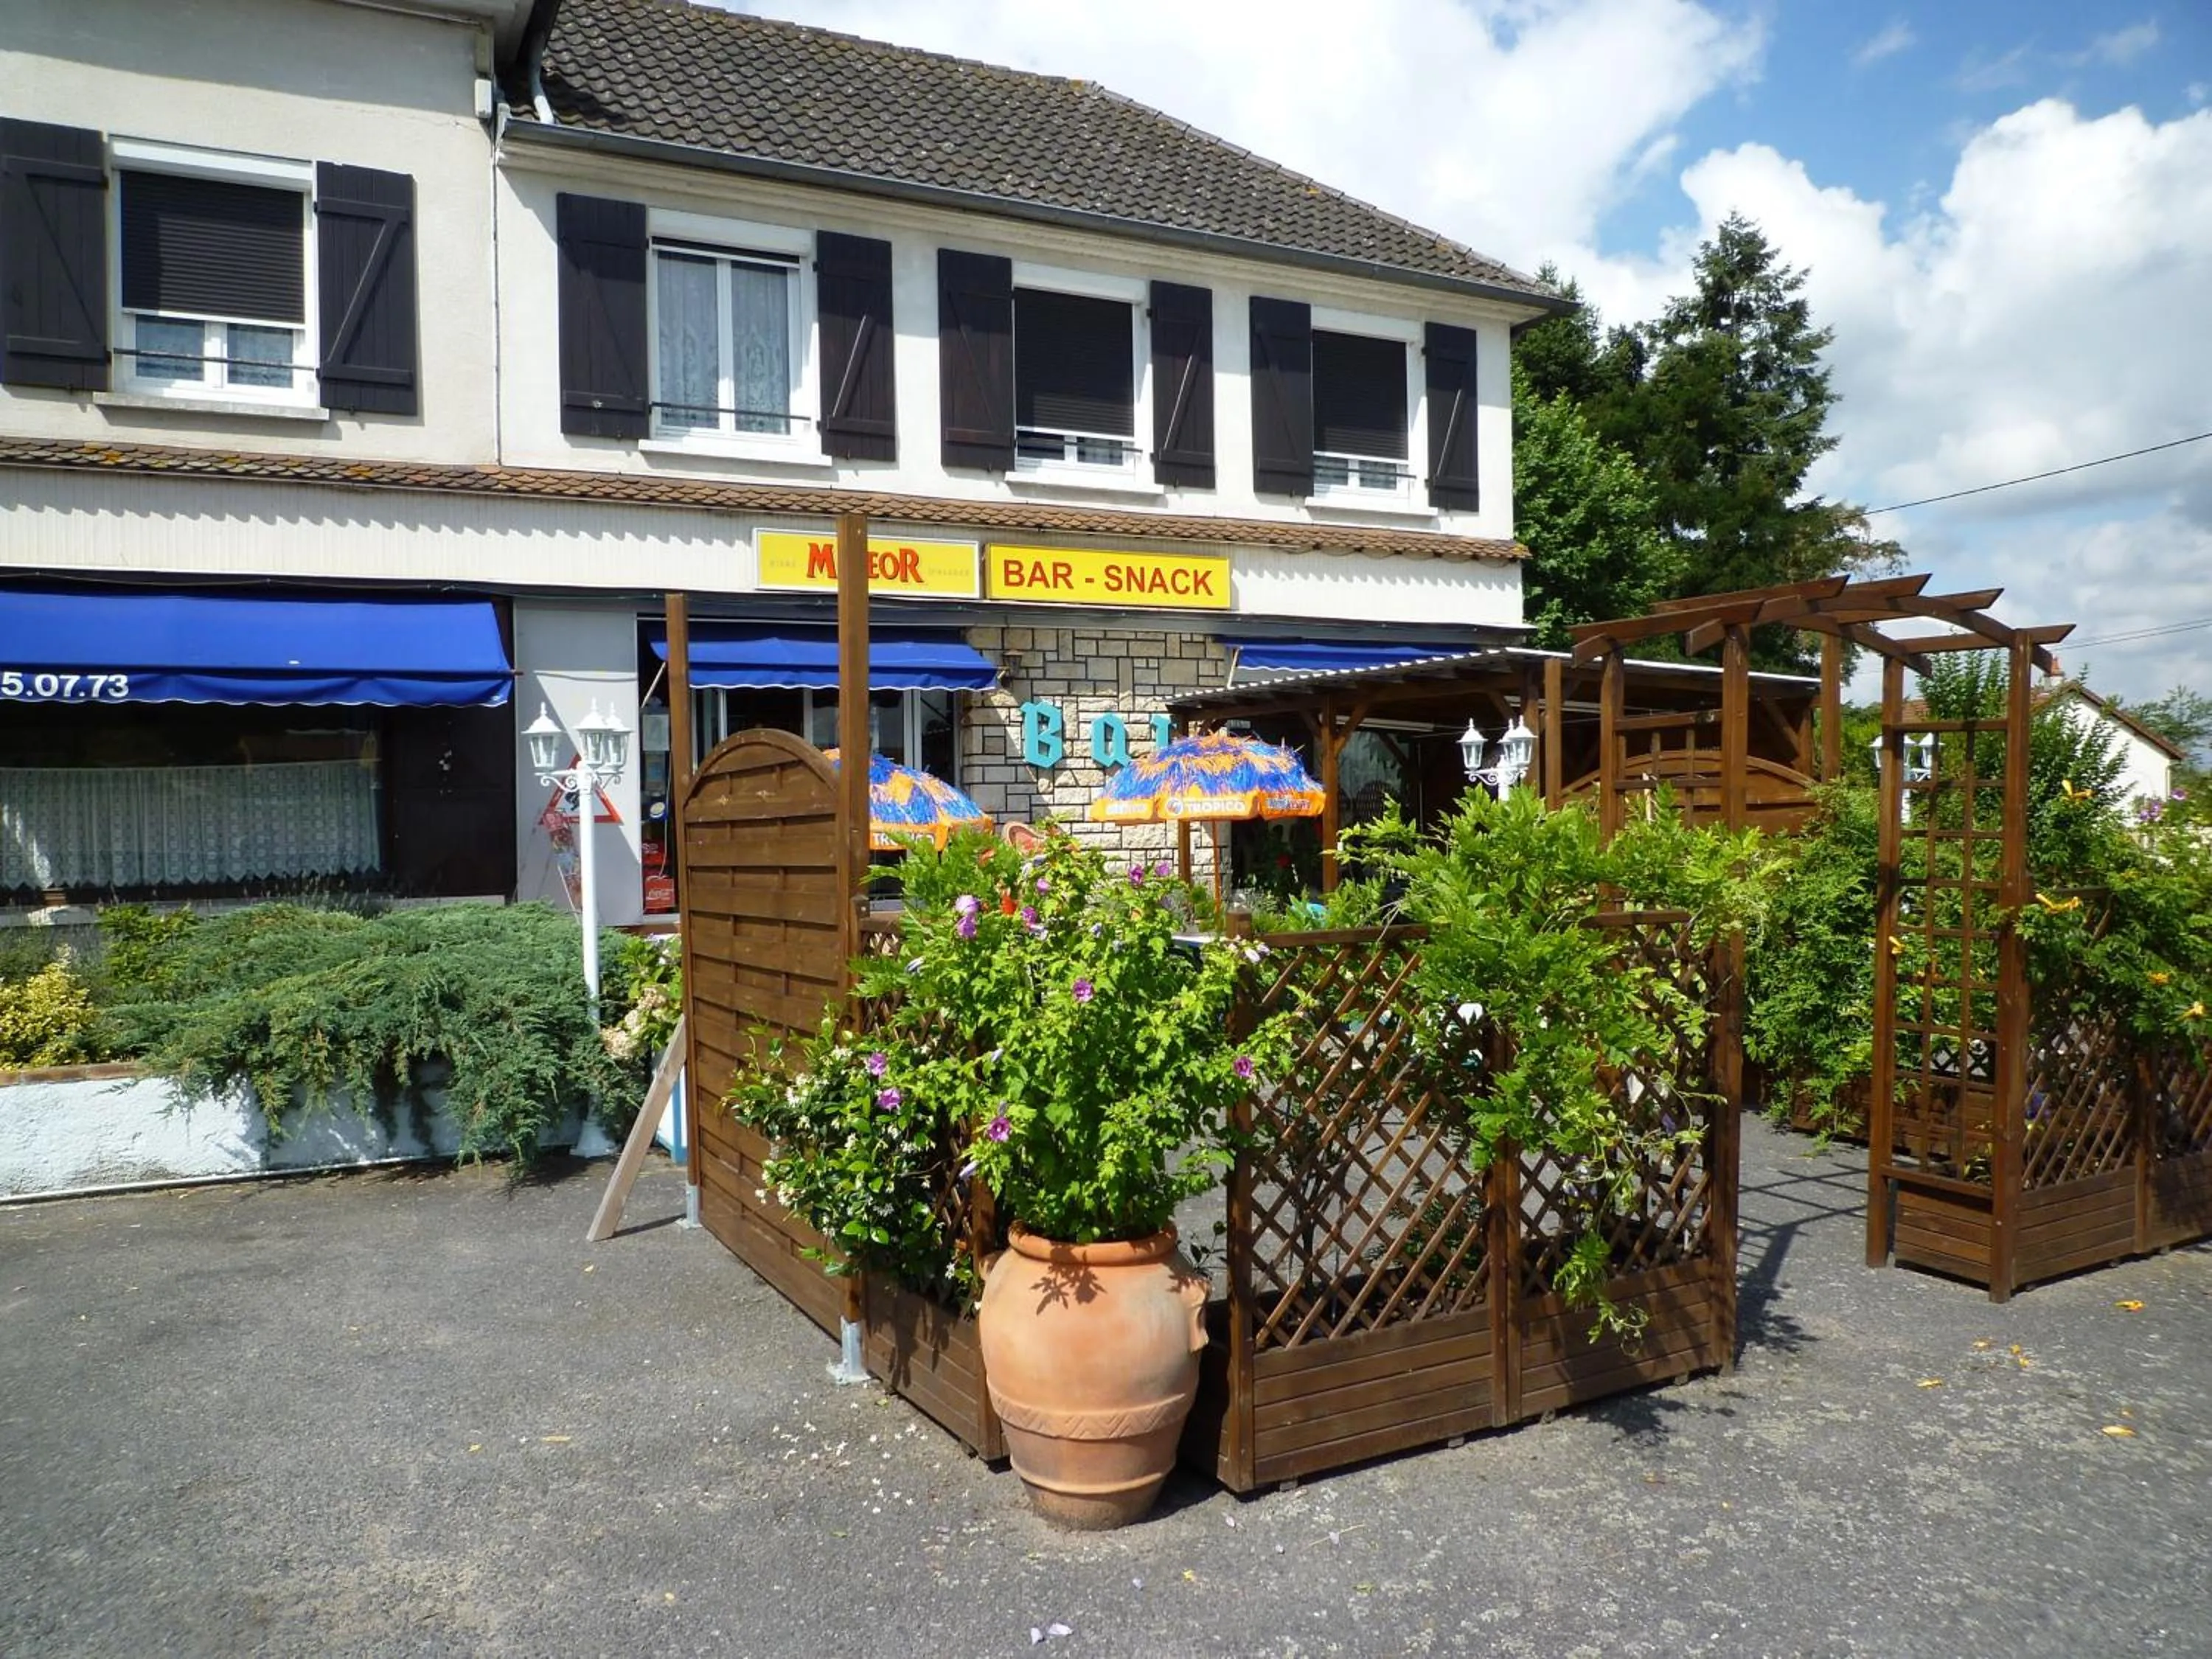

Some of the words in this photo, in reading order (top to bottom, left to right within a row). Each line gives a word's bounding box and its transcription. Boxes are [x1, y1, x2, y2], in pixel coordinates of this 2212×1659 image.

[806, 542, 924, 583] MEOR
[1004, 559, 1074, 589] BAR
[1104, 564, 1214, 597] SNACK
[0, 672, 129, 698] 5.07.73
[1184, 801, 1245, 813] TROPICO
